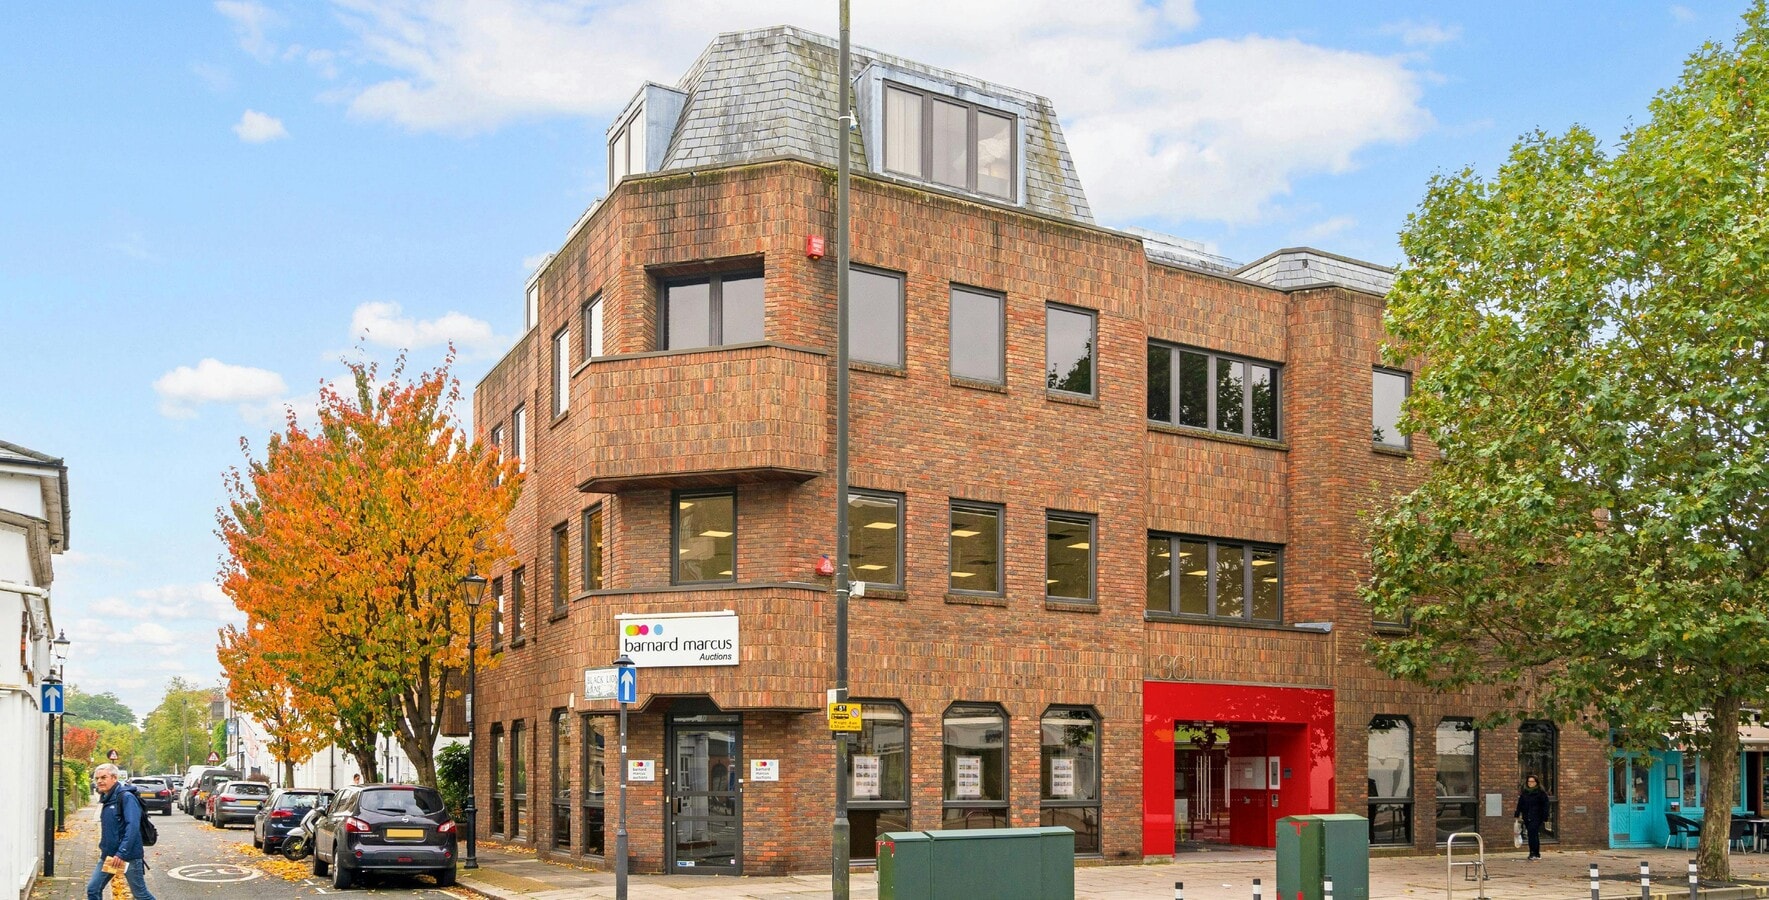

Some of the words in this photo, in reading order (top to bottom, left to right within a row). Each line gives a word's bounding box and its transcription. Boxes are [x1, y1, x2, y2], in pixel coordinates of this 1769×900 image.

[625, 637, 678, 652] barnard
[683, 639, 733, 651] marcus
[699, 653, 732, 661] Auctions
[588, 675, 604, 685] BLACK
